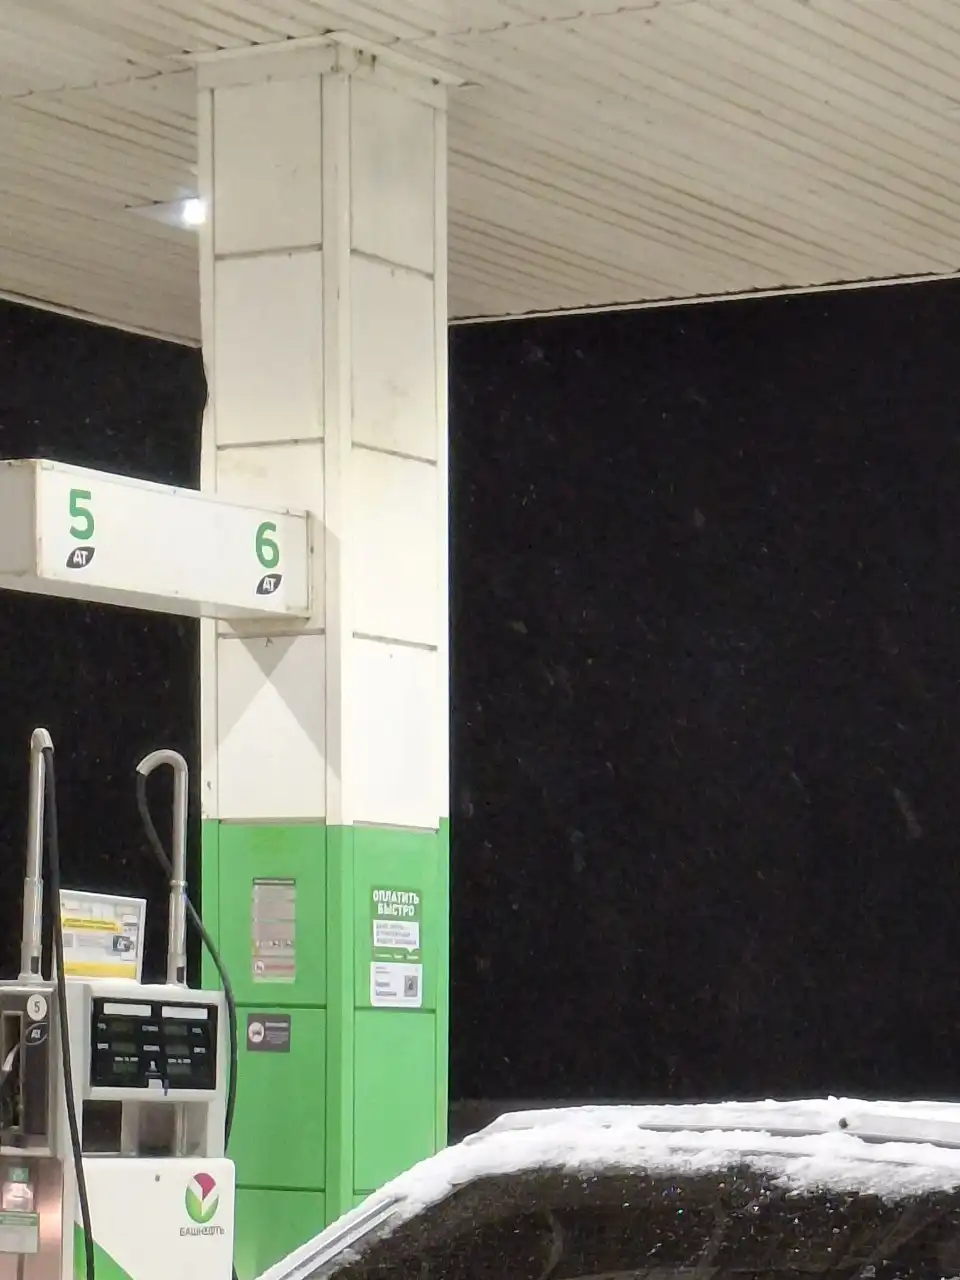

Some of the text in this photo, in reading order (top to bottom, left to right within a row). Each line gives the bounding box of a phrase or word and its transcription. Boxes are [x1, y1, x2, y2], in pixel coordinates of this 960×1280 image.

[69, 488, 95, 540] 5
[256, 521, 280, 569] 6
[373, 890, 419, 904] ОПЛАТИТЬ
[378, 903, 415, 917] БЫСТРО
[34, 1001, 40, 1013] 5
